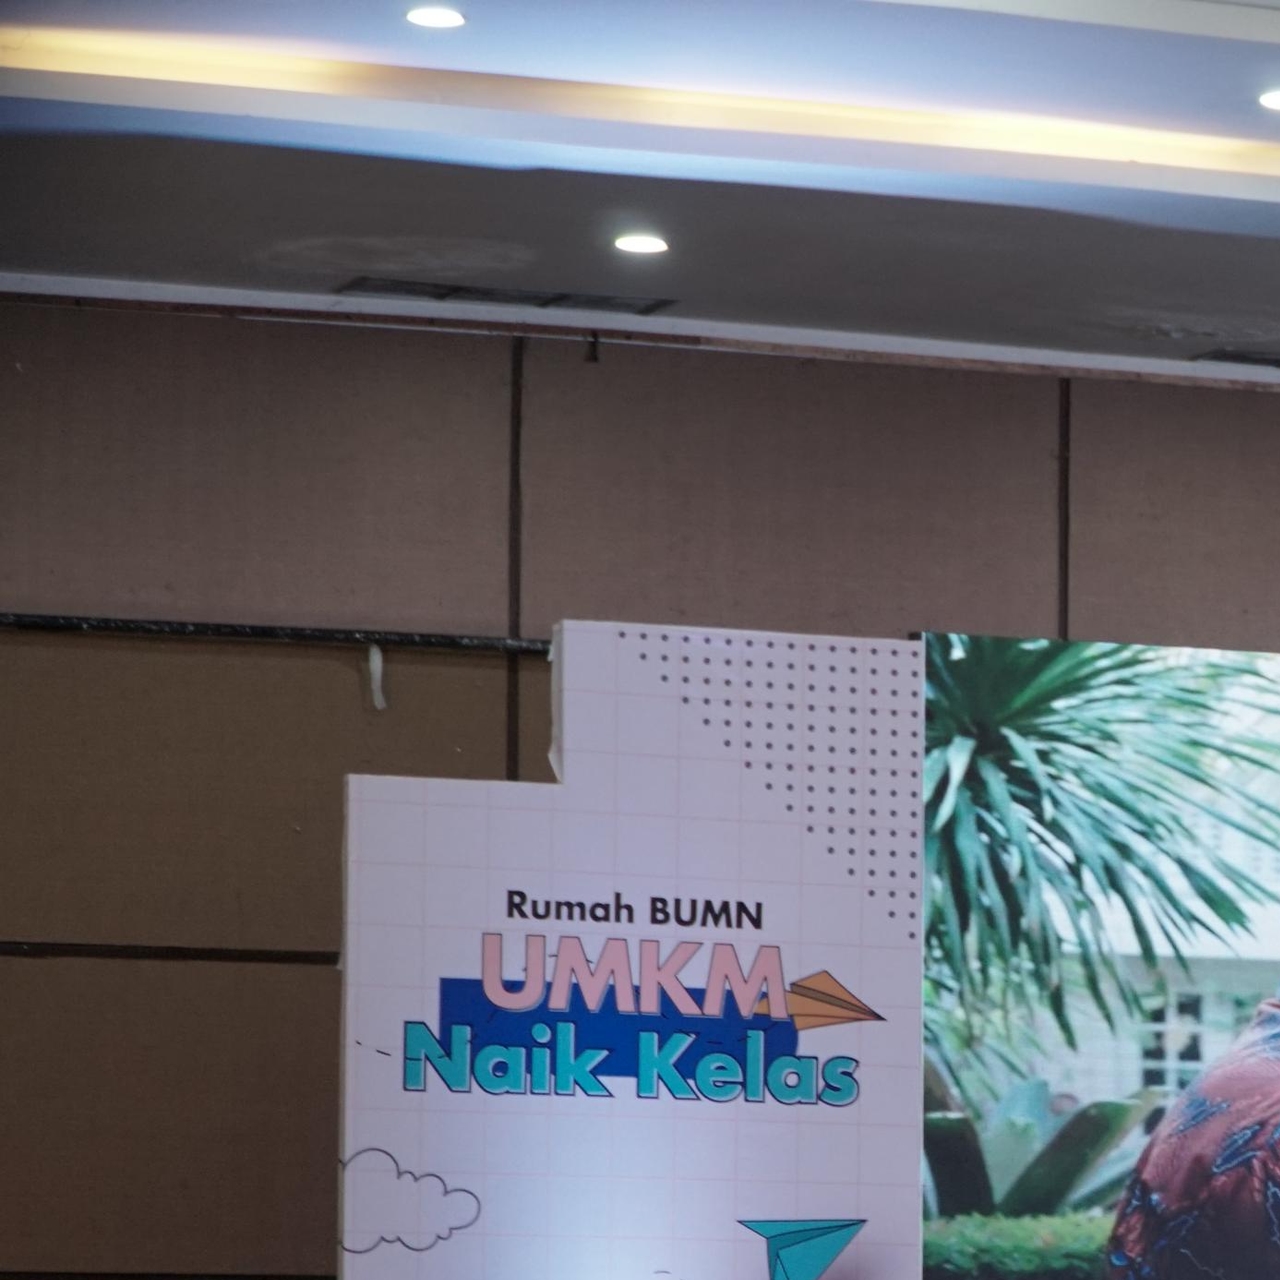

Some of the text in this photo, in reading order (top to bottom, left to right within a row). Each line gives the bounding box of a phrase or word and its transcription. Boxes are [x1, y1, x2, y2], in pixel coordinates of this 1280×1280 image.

[506, 890, 763, 929] Rumah BUMN
[481, 933, 791, 1021] UMKM
[403, 1021, 860, 1107] Naik Kelas
